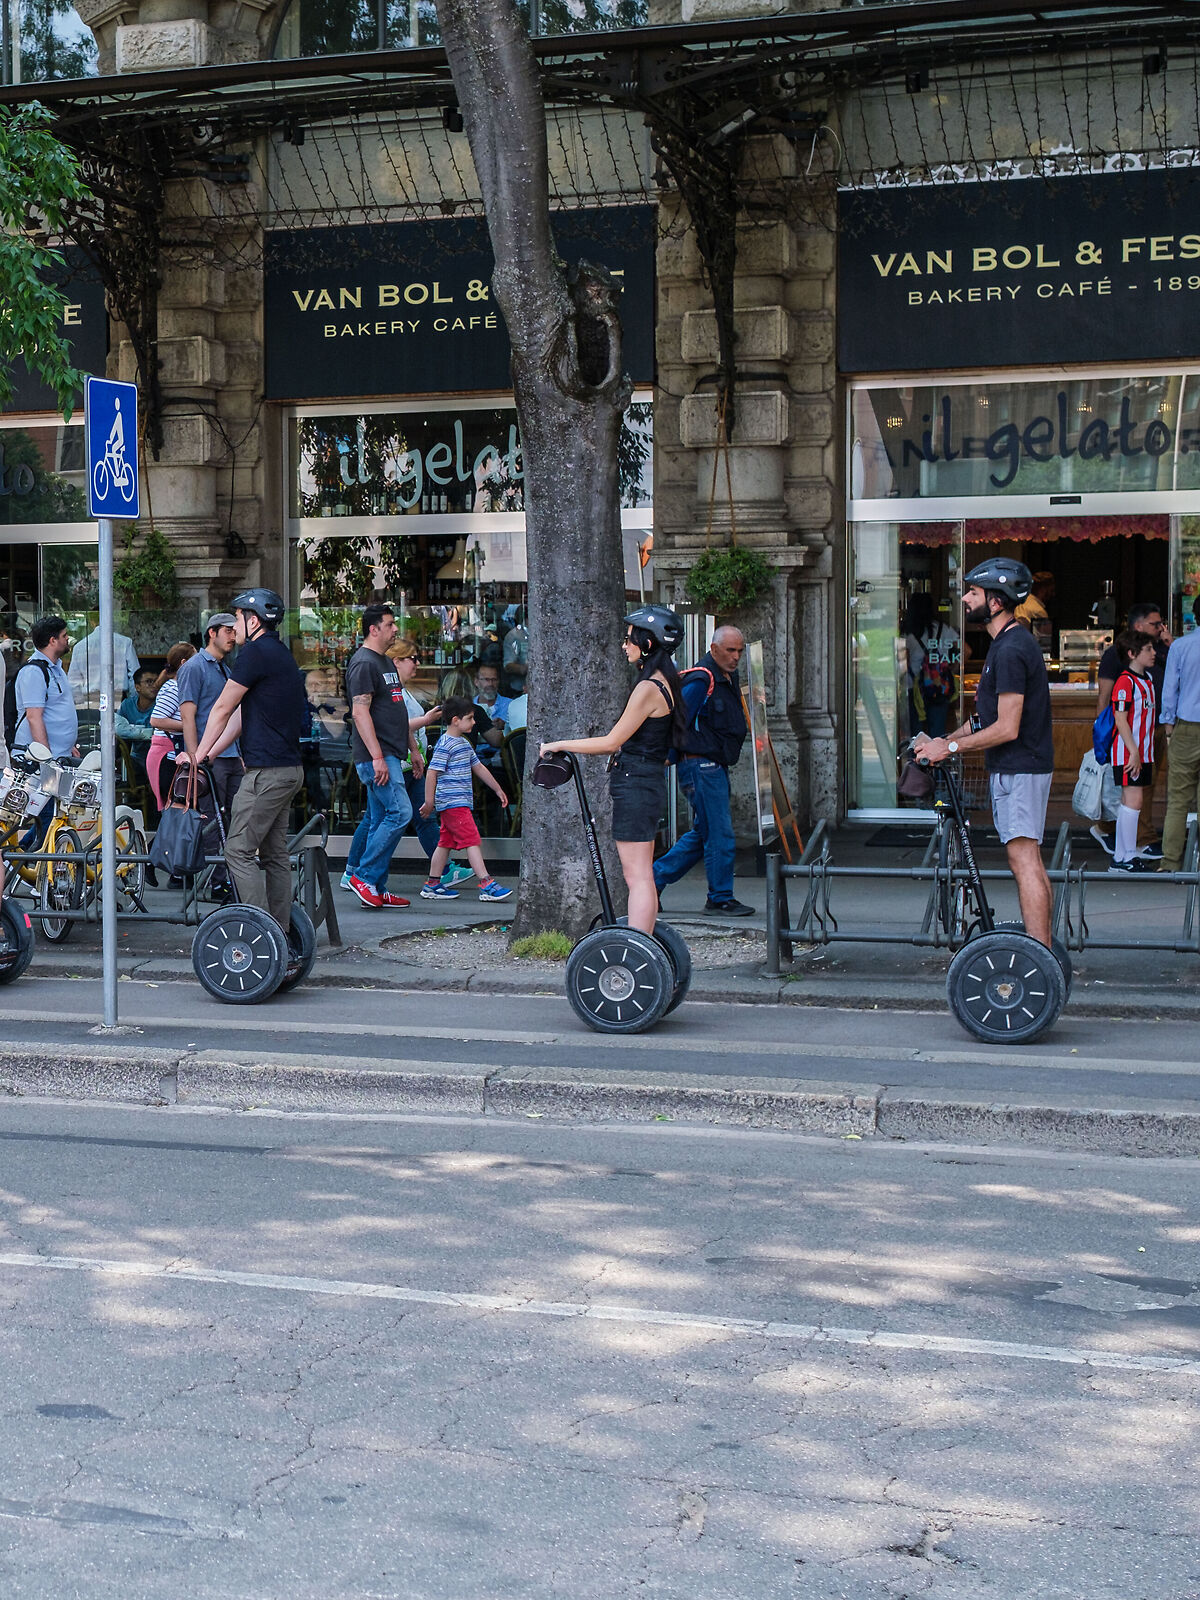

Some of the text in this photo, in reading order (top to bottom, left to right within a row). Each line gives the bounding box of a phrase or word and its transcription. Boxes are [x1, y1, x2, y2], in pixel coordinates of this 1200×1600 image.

[871, 234, 1200, 277] VAN BOL & FES
[292, 279, 489, 312] VAN BOL &
[907, 284, 1022, 306] BAKERY
[1037, 276, 1112, 299] CAFÉ
[324, 311, 498, 338] BAKERY CAFÉ
[921, 396, 960, 463] il
[340, 419, 526, 510] il gelat
